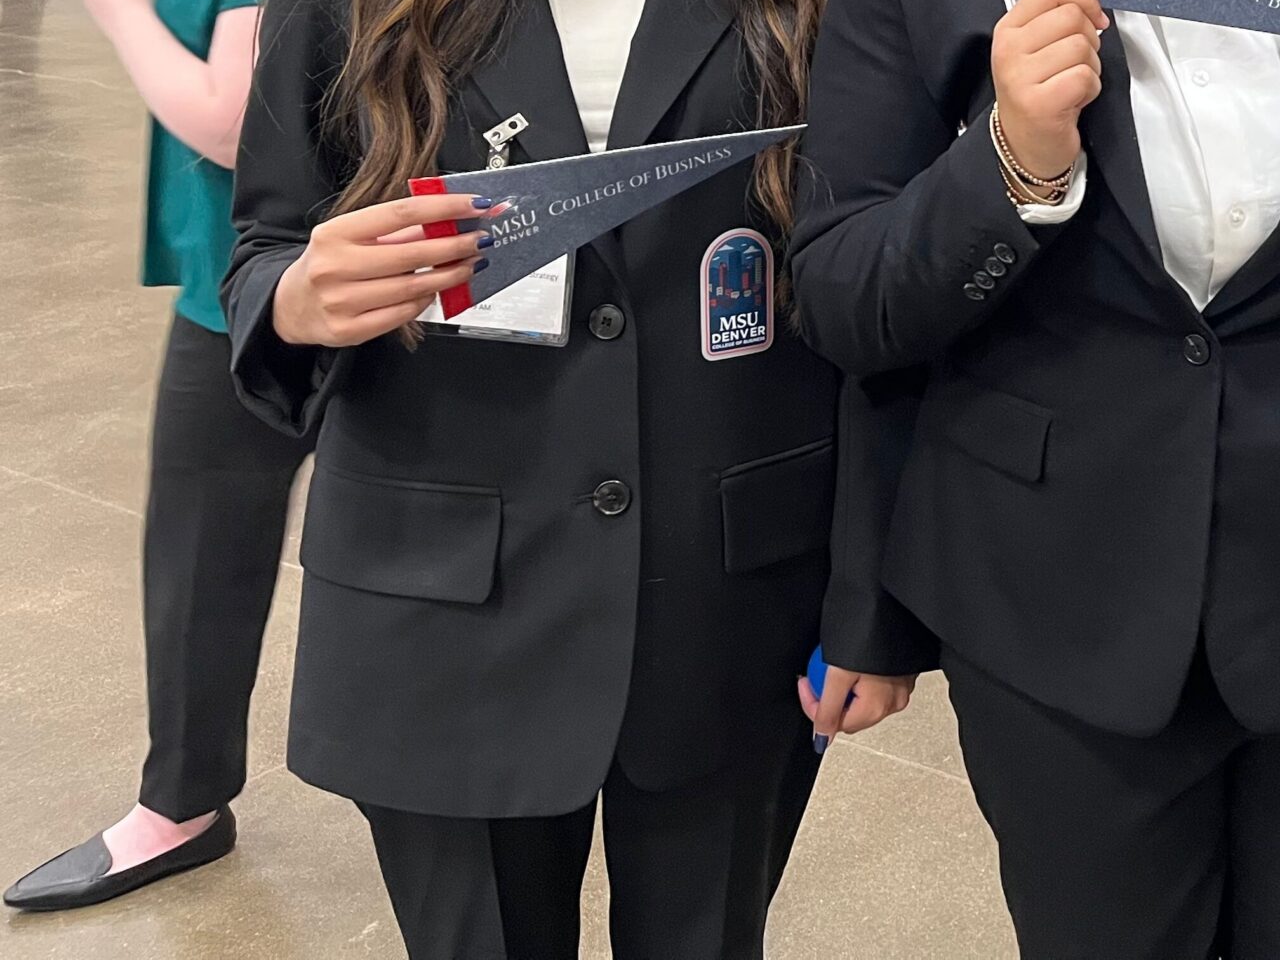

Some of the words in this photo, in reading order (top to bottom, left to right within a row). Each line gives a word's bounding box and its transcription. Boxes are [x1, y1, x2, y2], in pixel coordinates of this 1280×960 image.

[549, 181, 626, 216] COLLEGE
[629, 171, 652, 188] OF
[655, 146, 732, 180] BUSINESS
[491, 210, 536, 239] MSU
[493, 226, 540, 249] DENVER
[719, 311, 759, 332] MSU
[711, 325, 766, 345] DENVER
[711, 341, 735, 350] COLLEGE
